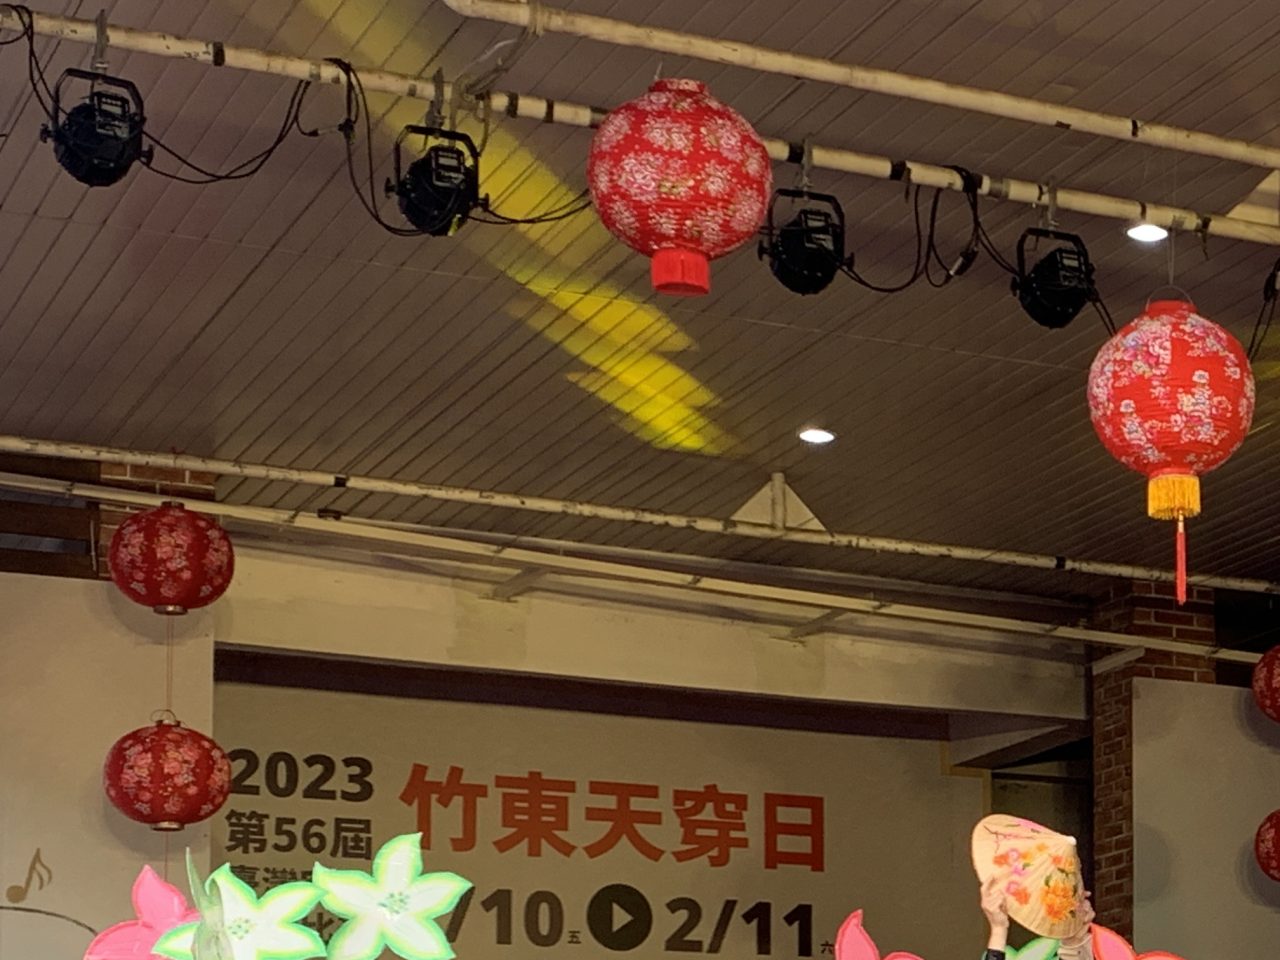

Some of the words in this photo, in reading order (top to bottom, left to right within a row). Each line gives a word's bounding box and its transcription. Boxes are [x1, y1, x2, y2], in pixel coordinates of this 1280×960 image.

[228, 748, 374, 803] 2023
[225, 809, 372, 860] 第56屆
[399, 763, 826, 872] 竹東天穿日
[664, 897, 813, 957] 2/11
